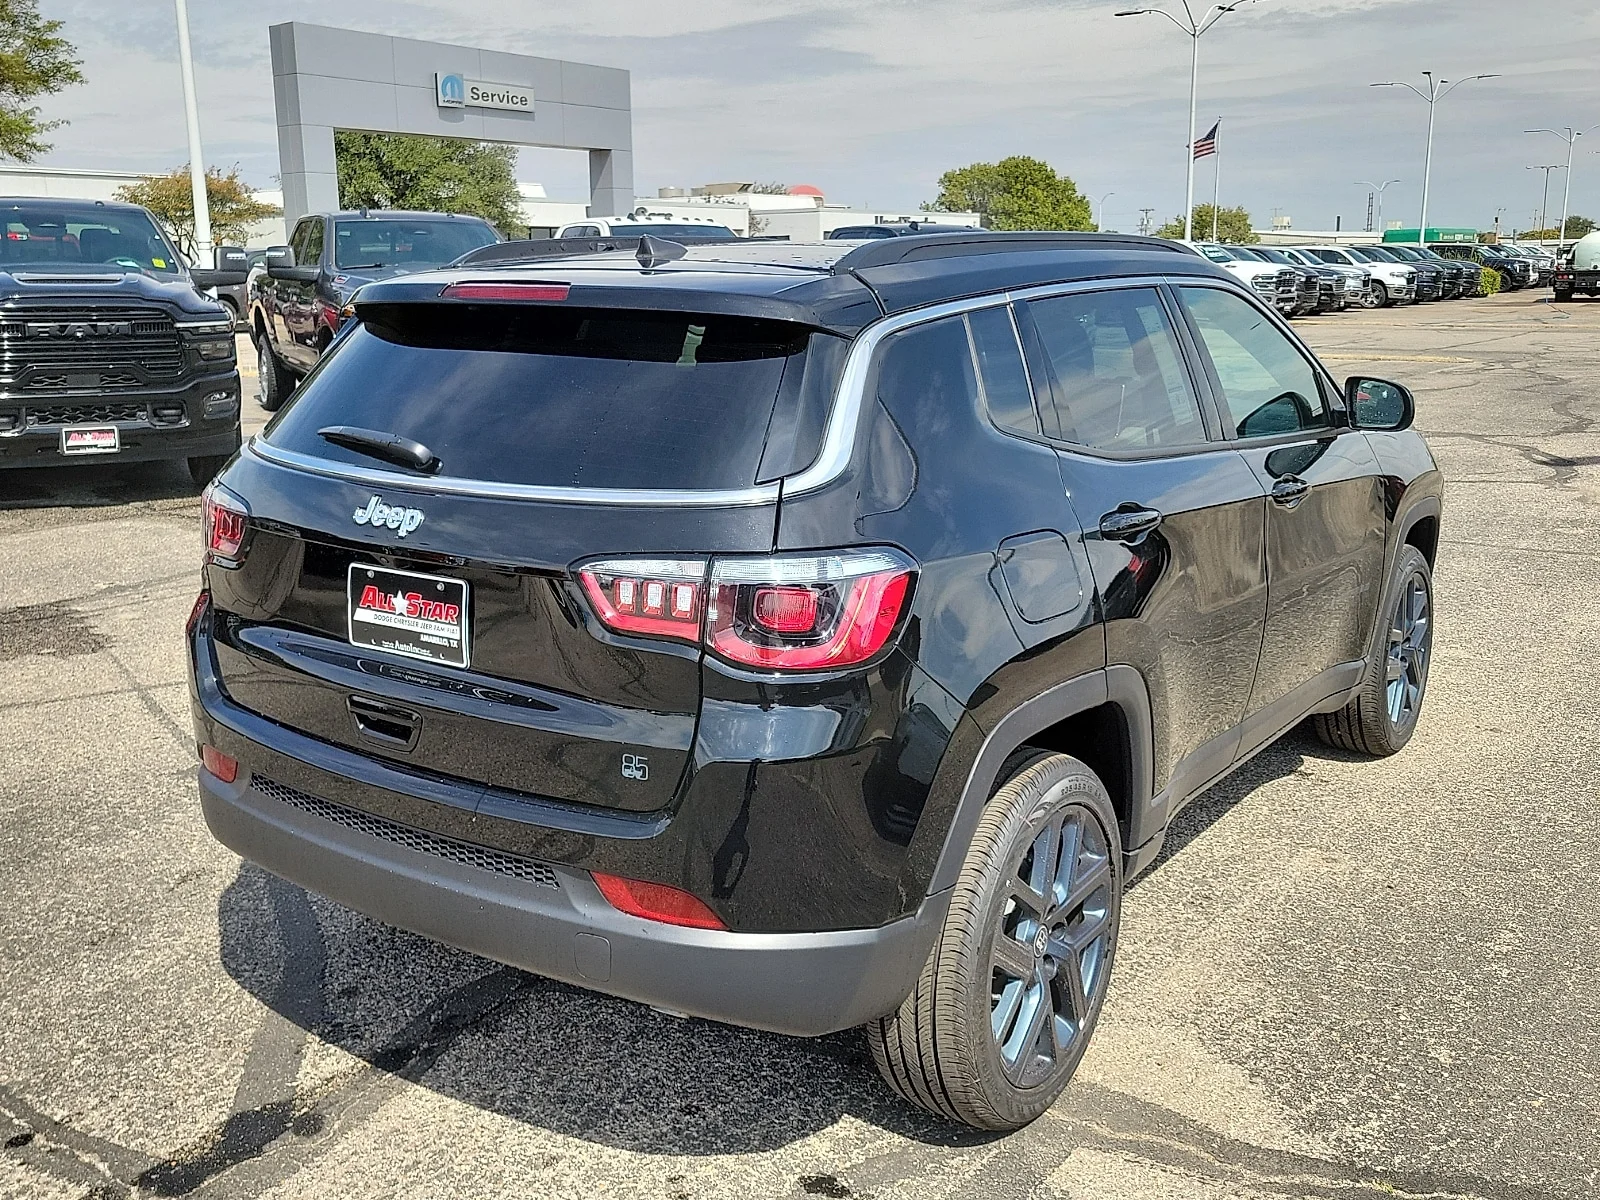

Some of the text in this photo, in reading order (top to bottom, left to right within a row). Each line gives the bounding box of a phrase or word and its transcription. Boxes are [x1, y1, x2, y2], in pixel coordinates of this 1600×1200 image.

[470, 86, 528, 106] Service
[26, 321, 131, 337] RAM
[352, 493, 426, 538] Jeep
[404, 591, 460, 625] STAR
[373, 613, 393, 623] DODGE
[393, 616, 420, 628] CHRYSLER
[622, 753, 649, 780] 85
